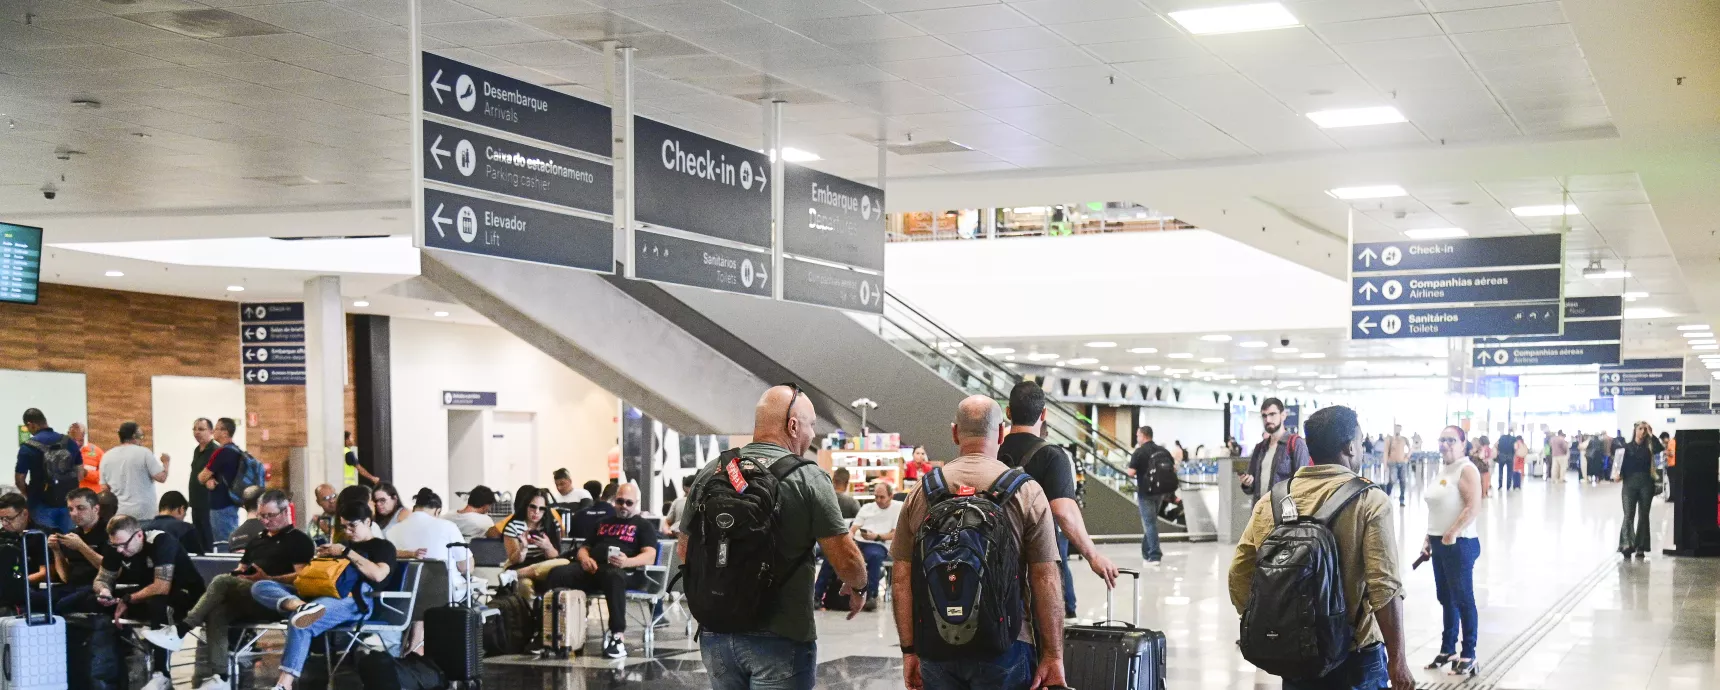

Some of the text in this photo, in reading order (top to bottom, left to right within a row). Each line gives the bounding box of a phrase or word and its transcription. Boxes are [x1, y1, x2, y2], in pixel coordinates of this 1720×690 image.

[484, 81, 548, 112] Desembarque
[484, 101, 519, 123] Arrivals
[485, 146, 512, 164] Caixa
[526, 158, 594, 184] estacionamento
[662, 139, 735, 186] Check-in
[486, 164, 551, 191] Parking cashier
[812, 182, 858, 214] Embarque
[485, 210, 527, 231] Elevador
[485, 230, 500, 246] Lift
[1408, 244, 1454, 255] Check-in
[1409, 276, 1509, 289] Companhias aéreas
[1409, 289, 1445, 299] Airlines
[1408, 313, 1459, 324] Sanitários
[1408, 324, 1439, 333] Toilets
[1513, 348, 1559, 358] Companhias
